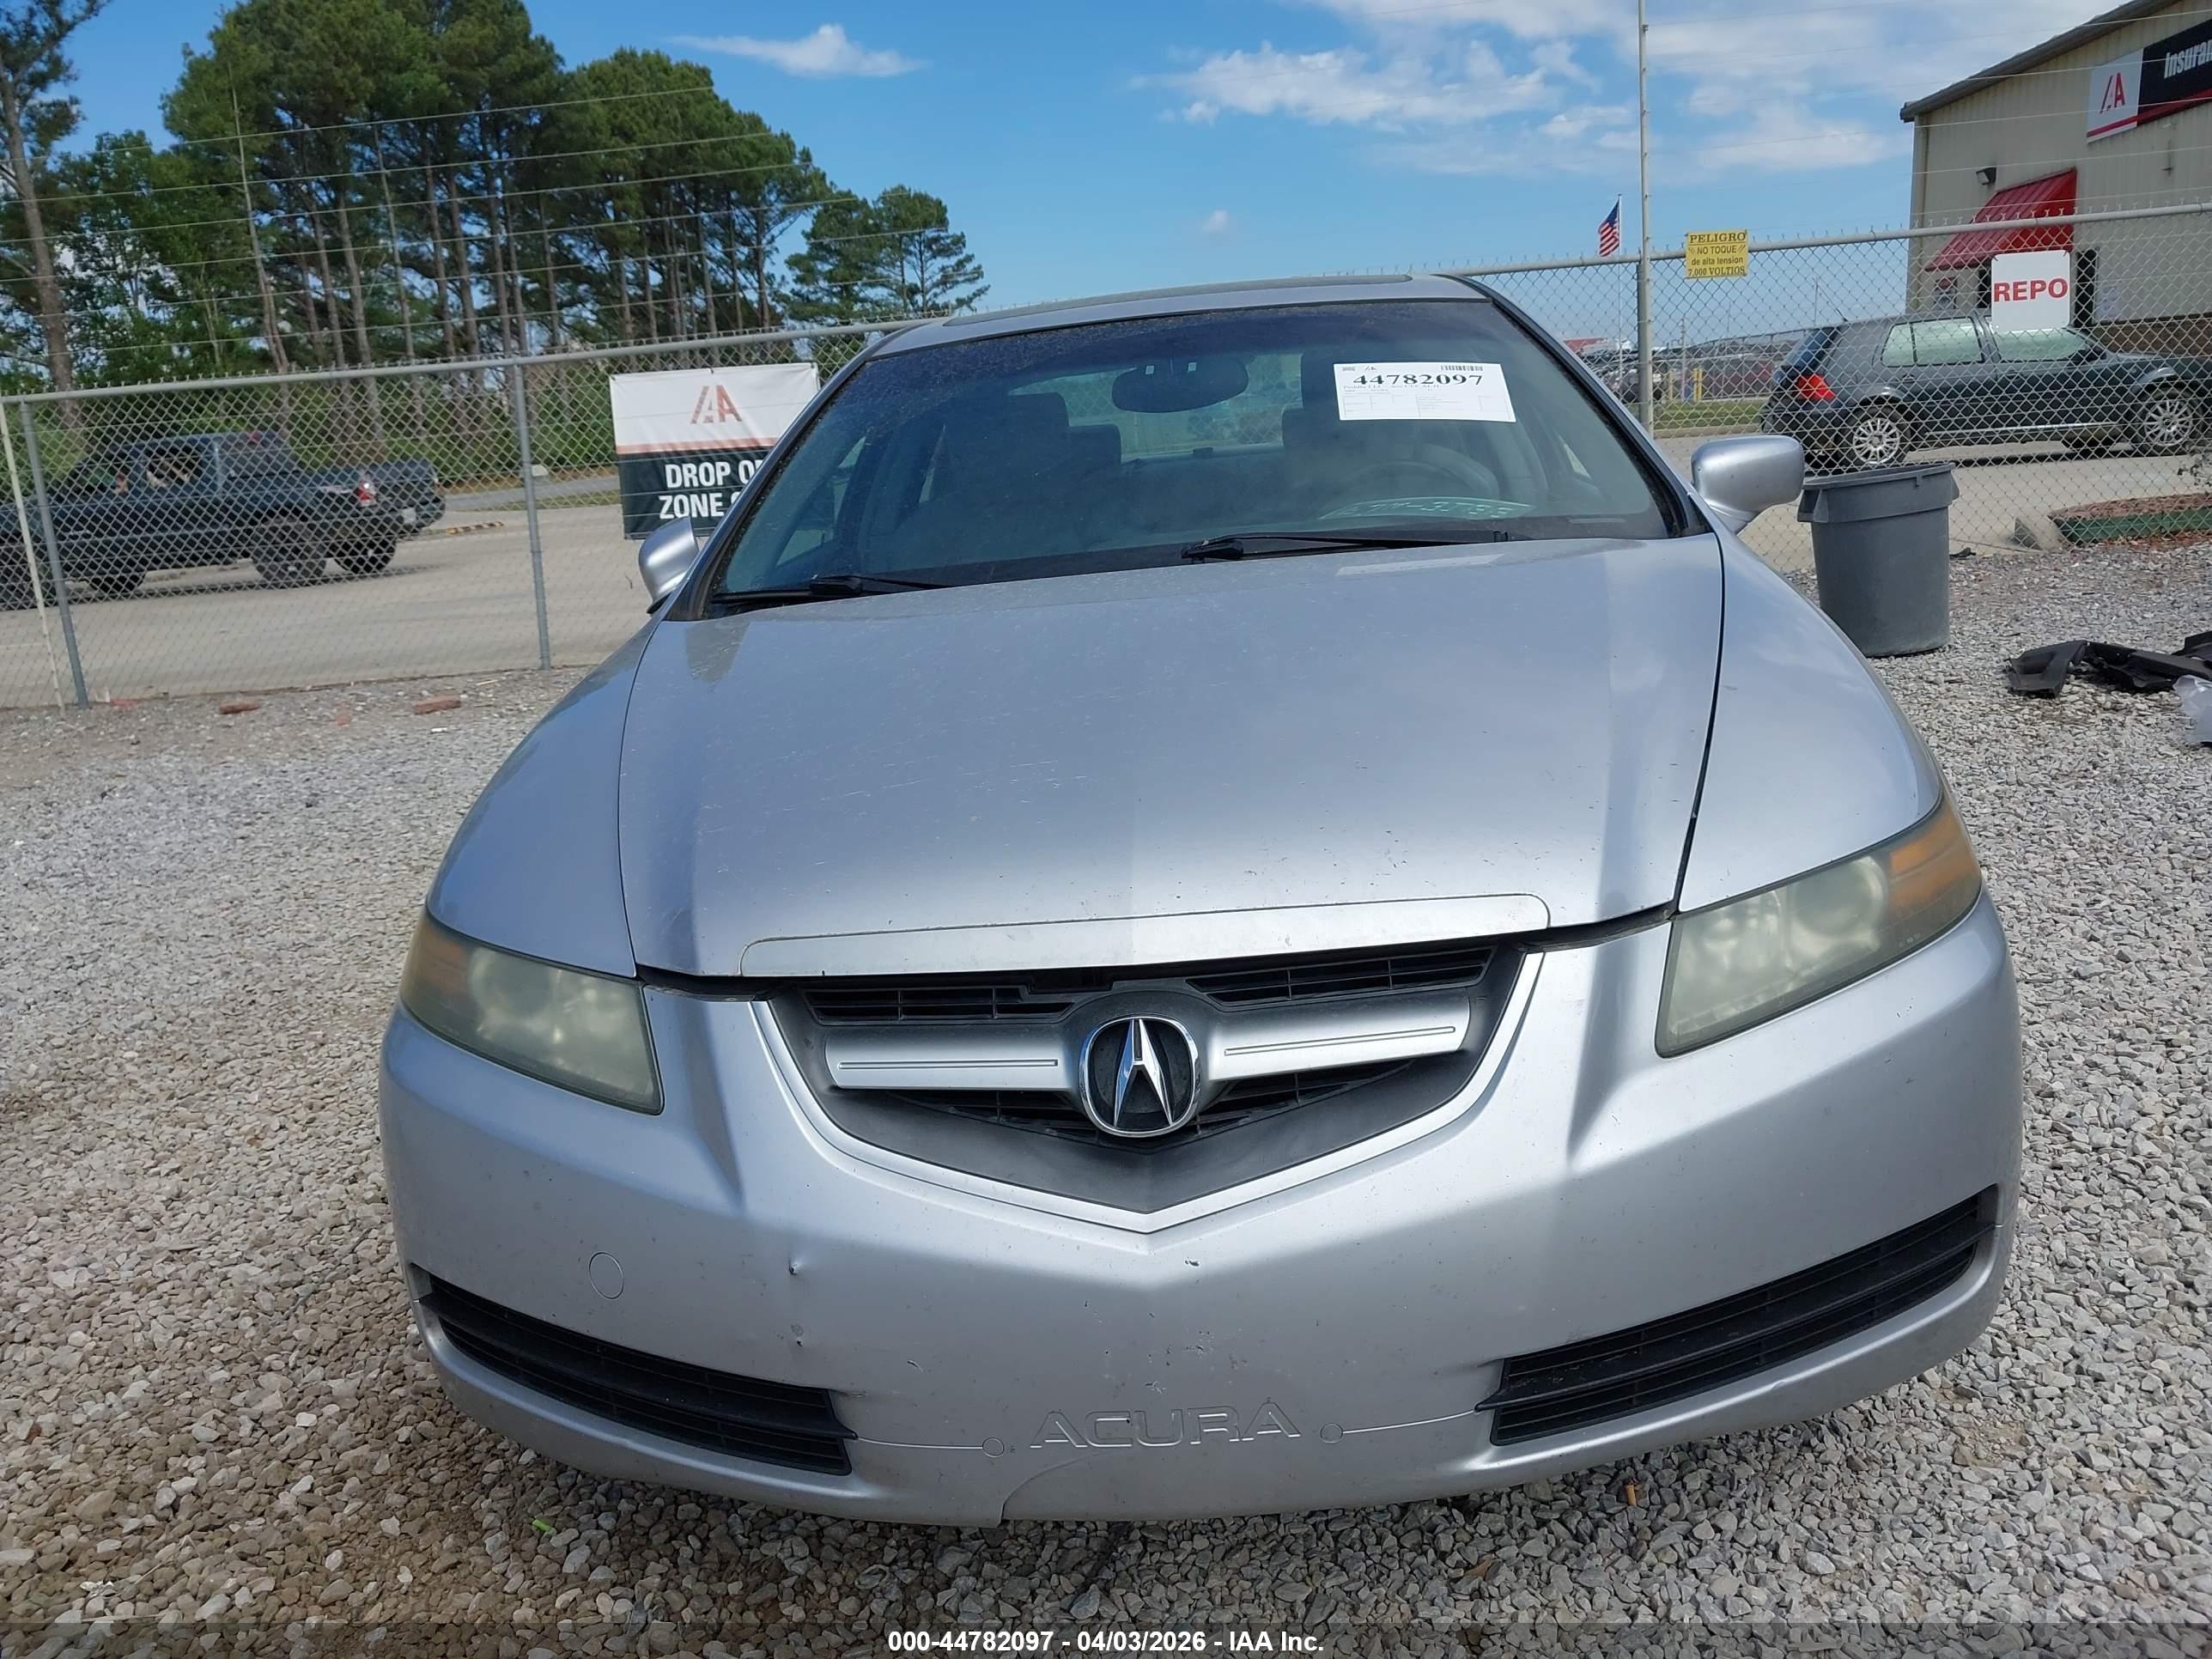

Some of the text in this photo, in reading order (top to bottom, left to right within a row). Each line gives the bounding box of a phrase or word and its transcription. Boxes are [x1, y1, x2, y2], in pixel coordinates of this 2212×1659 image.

[1689, 232, 1746, 243] PELIGRO
[1697, 245, 1737, 255] NO TOQUE
[1709, 265, 1745, 276] VOLTIOS
[1993, 278, 2068, 302] REPO
[1353, 374, 1483, 386] 44782097
[665, 461, 731, 488] DROP
[658, 492, 725, 520] ZONE
[1030, 1401, 1301, 1448] ACURA
